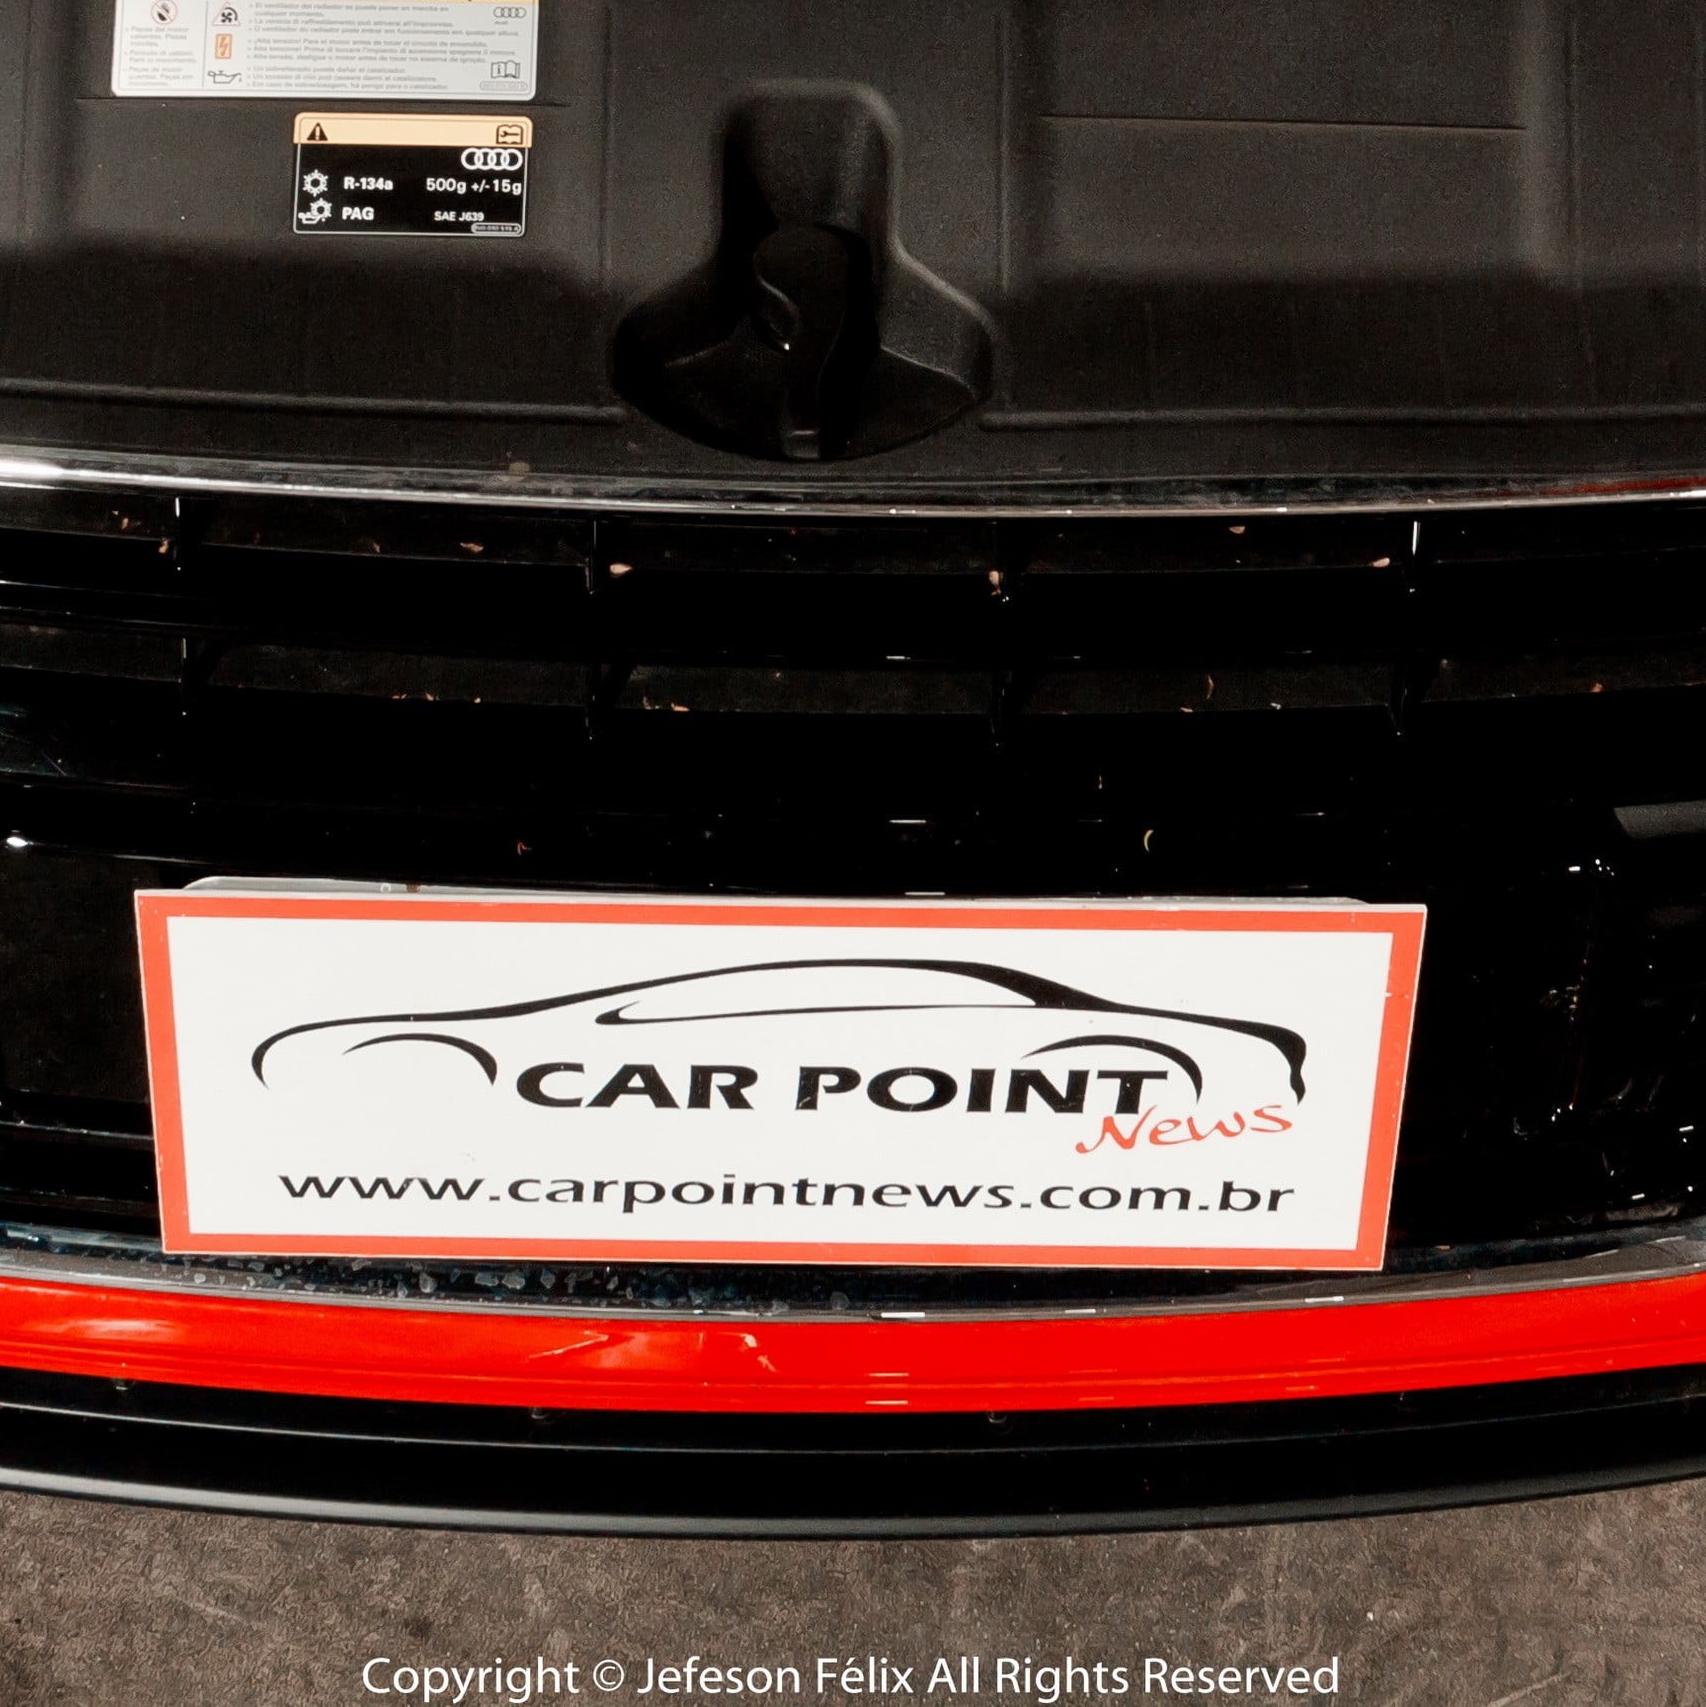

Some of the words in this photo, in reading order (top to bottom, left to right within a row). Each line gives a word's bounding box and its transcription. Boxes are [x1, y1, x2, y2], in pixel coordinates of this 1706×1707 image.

[344, 176, 393, 191] R-134a
[426, 178, 467, 195] 500g
[342, 206, 375, 221] PAG
[434, 210, 456, 221] SAE
[458, 211, 484, 222] J639
[516, 1062, 759, 1109] CAR
[795, 1066, 1169, 1114] POINT
[1075, 1105, 1293, 1154] News
[279, 1173, 1294, 1213] www.carpointnews.com.br
